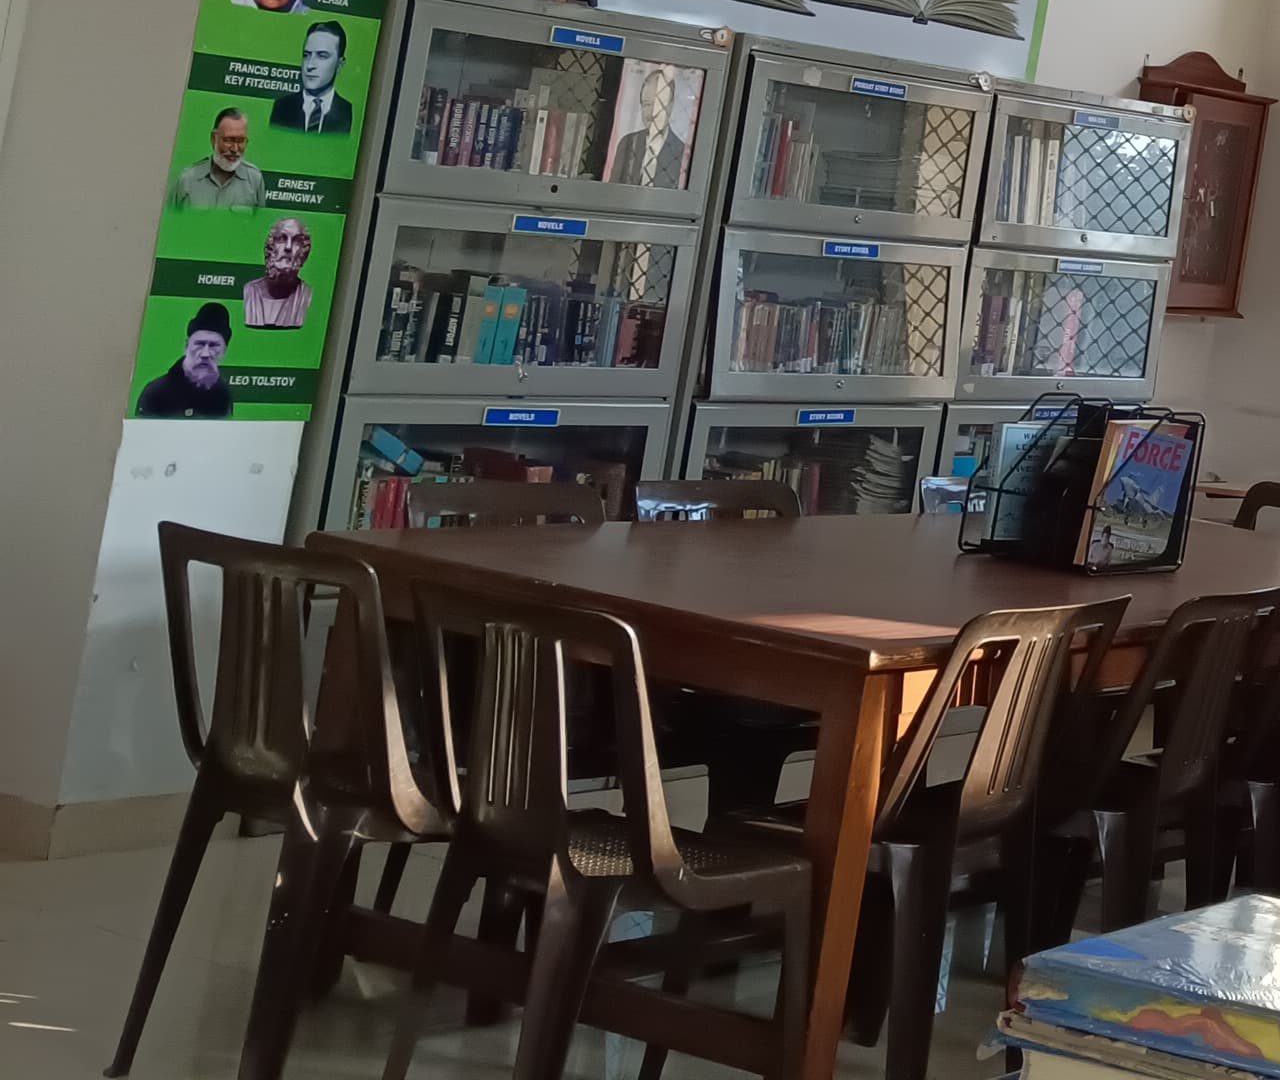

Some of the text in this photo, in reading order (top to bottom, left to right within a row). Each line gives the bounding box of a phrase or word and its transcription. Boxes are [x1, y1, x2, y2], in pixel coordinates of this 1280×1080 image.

[229, 62, 301, 81] FRANCIS SCOTT
[224, 75, 301, 94] KEY FITZGERALD
[278, 178, 316, 192] ERNEST
[265, 189, 324, 205] HEMINGWAY
[197, 273, 236, 287] HOMER
[229, 374, 296, 388] LEO TOLSTOY
[1122, 430, 1187, 473] FORCE
